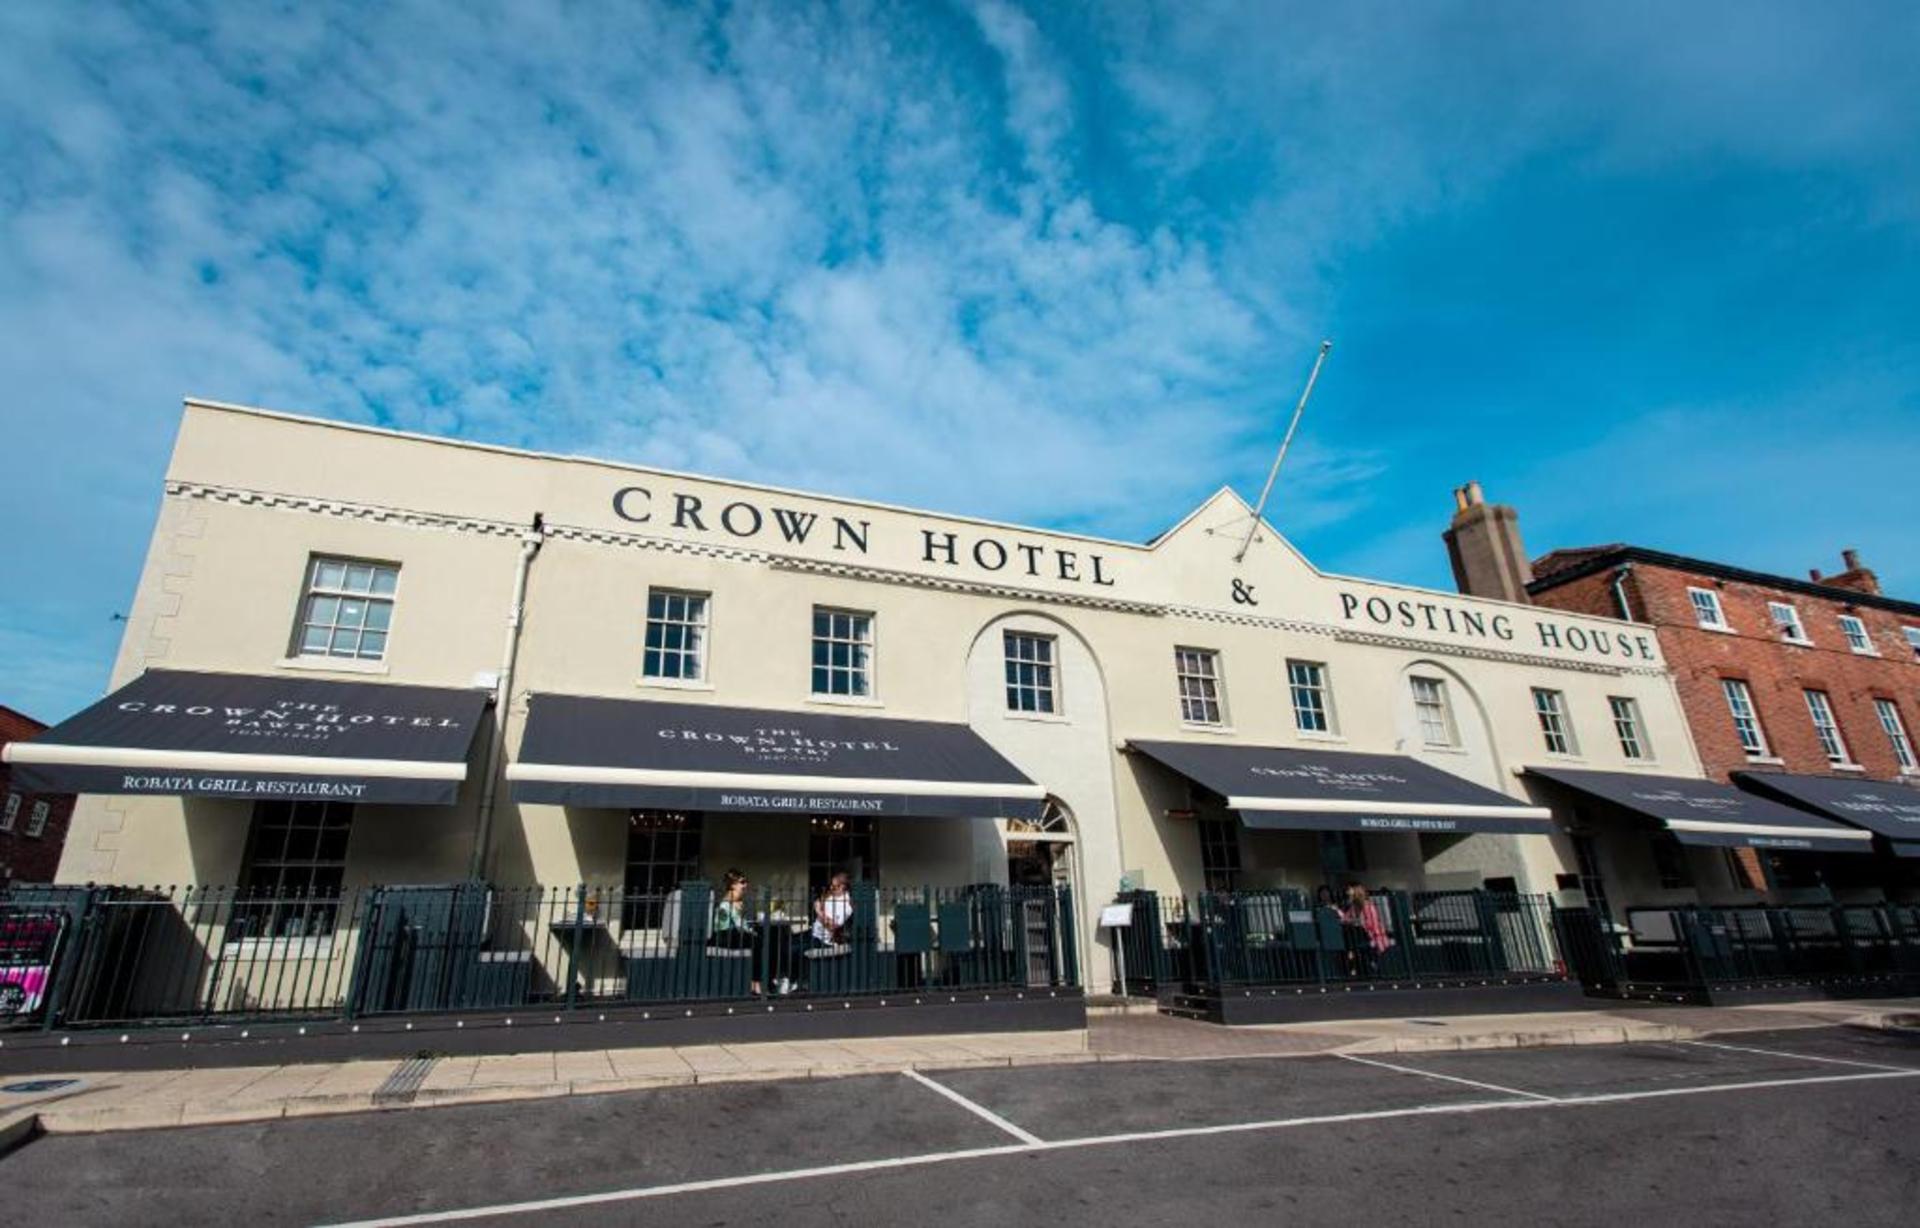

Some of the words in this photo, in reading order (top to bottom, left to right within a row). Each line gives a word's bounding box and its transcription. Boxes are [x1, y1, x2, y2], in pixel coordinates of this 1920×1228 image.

[613, 486, 870, 553] CROWN
[920, 530, 1115, 586] HOTEL
[1231, 578, 1259, 606] &
[1339, 593, 1514, 641] POSTING
[1535, 622, 1655, 661] HOUSE
[118, 702, 290, 719] CROWN
[315, 713, 460, 728] HOTEL
[658, 729, 776, 746] CROWN
[794, 737, 900, 751] HOTEL
[123, 775, 194, 790] ROBATA
[199, 778, 251, 793] GRILL
[255, 780, 367, 797] RESTAURANT
[721, 794, 769, 808] ROBATA
[771, 796, 808, 808] GRILL
[809, 797, 884, 811] RESTAURANT
